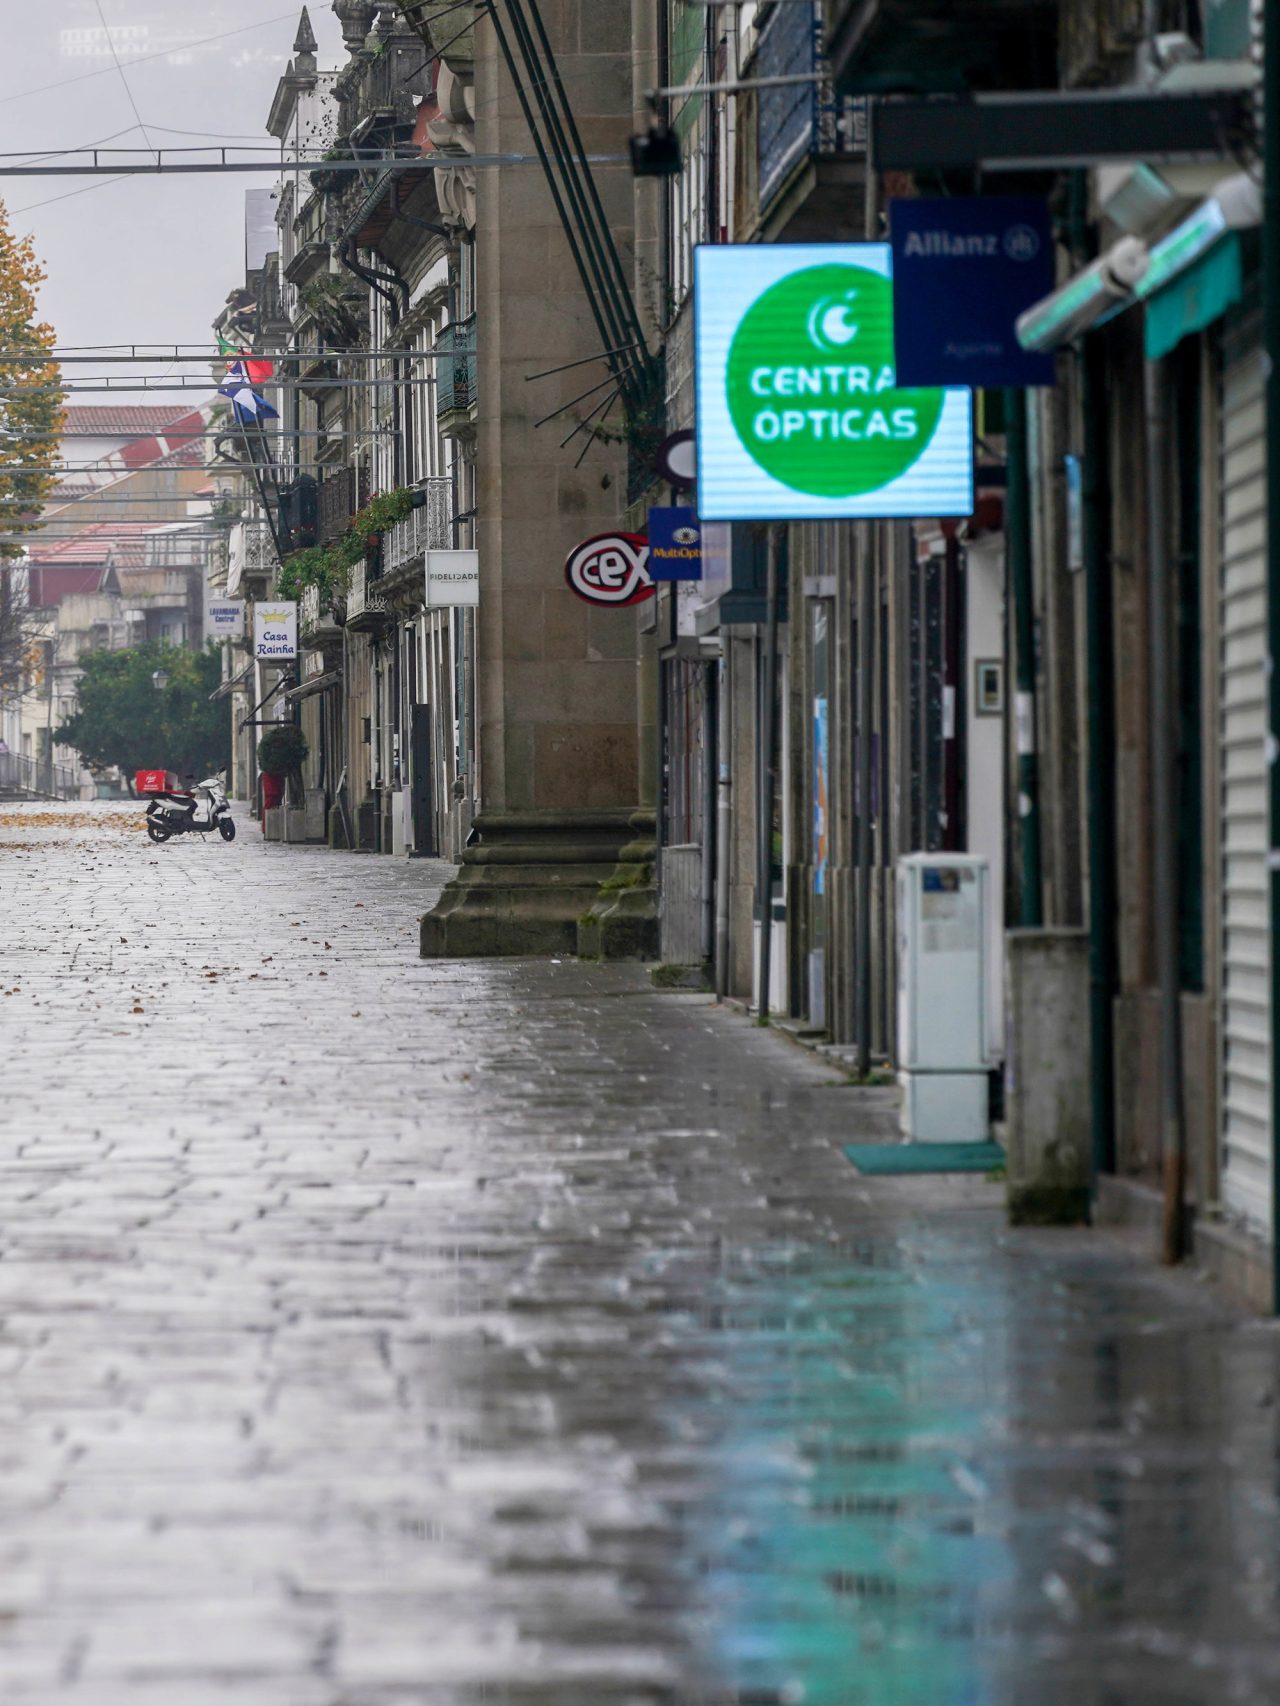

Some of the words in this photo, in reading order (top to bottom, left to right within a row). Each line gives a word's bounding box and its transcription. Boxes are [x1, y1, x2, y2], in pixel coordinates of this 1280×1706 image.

[904, 230, 998, 257] Allianz
[750, 365, 896, 395] CENTRA
[263, 631, 288, 641] Casa
[257, 644, 294, 655] Rainha
